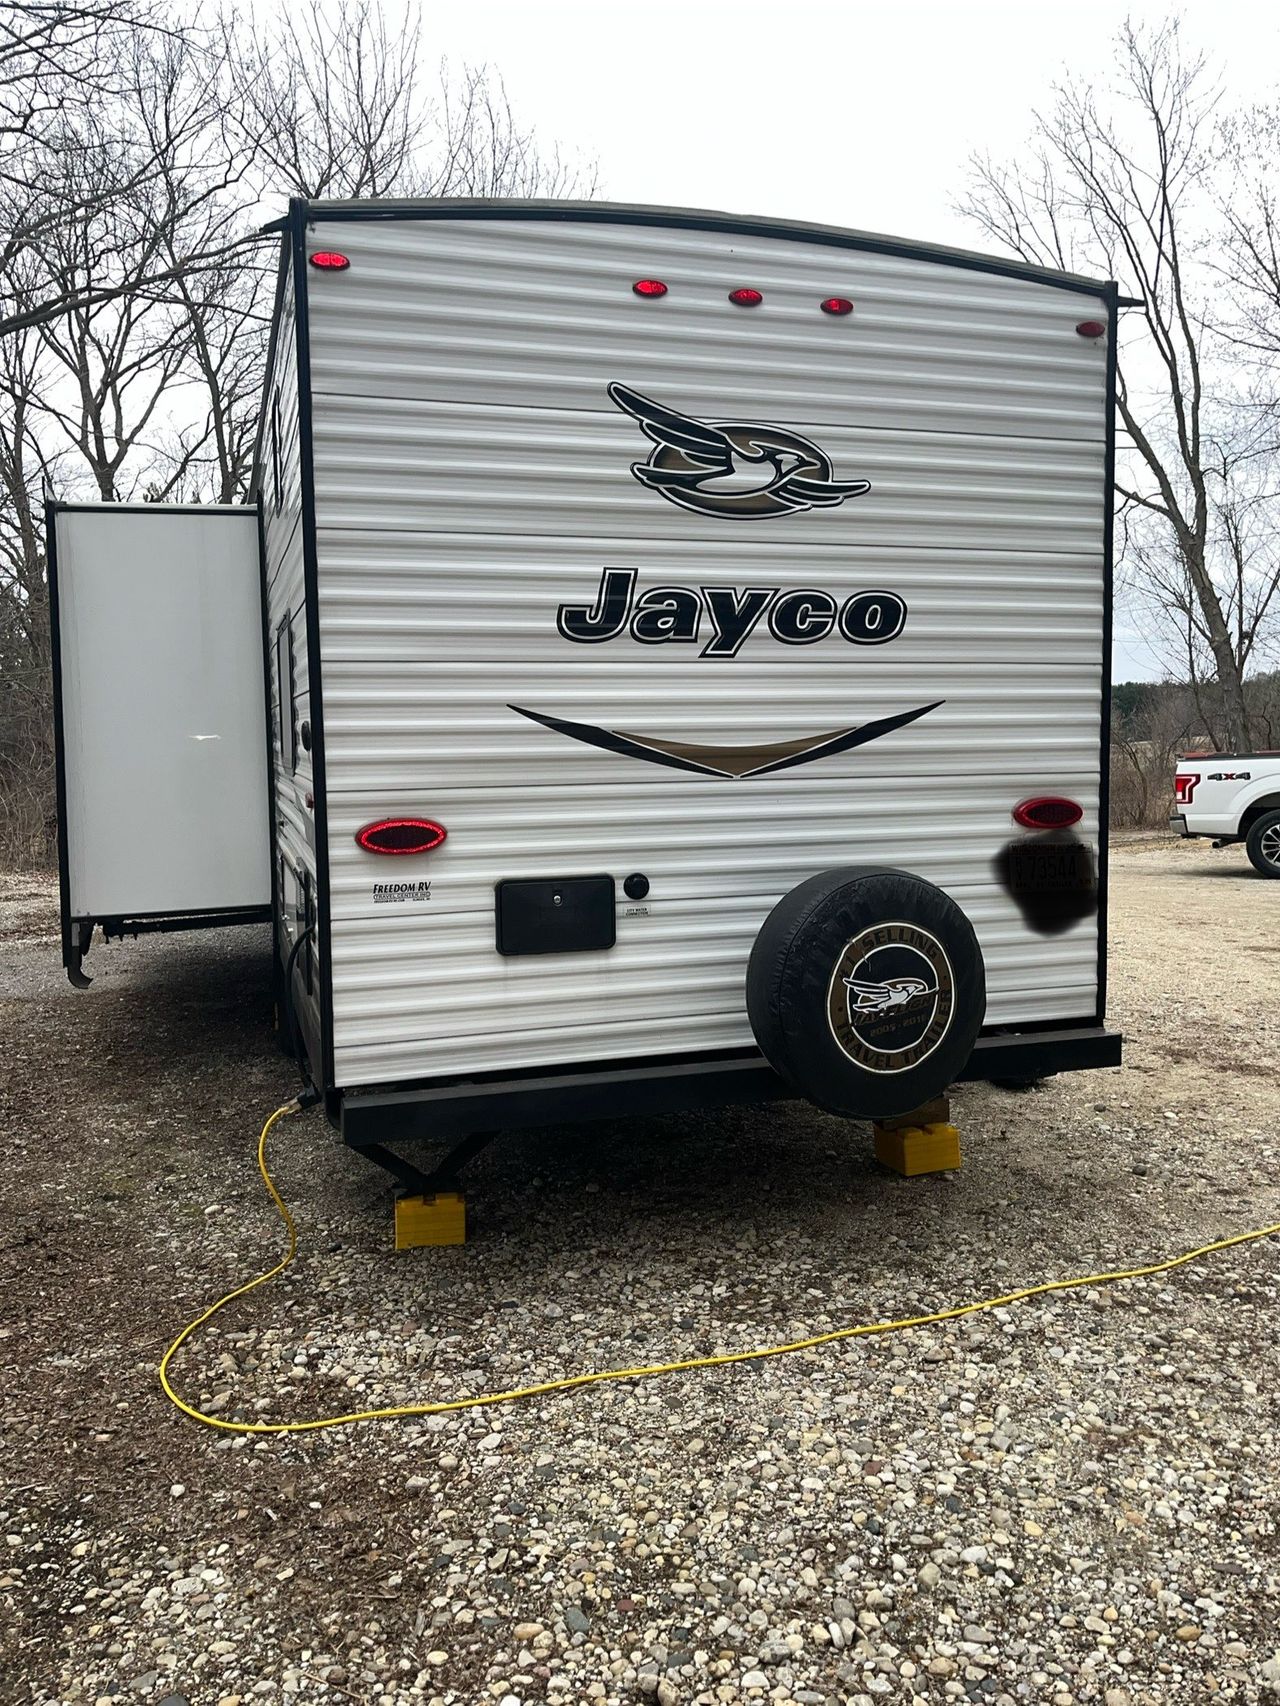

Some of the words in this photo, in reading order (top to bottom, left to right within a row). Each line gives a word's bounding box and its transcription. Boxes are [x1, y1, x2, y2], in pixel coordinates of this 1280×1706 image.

[557, 567, 908, 658] Jayco
[373, 883, 415, 894] FREEDOM
[418, 881, 431, 891] RV
[861, 927, 941, 959] SELLING
[836, 1022, 896, 1068] TRAVEL
